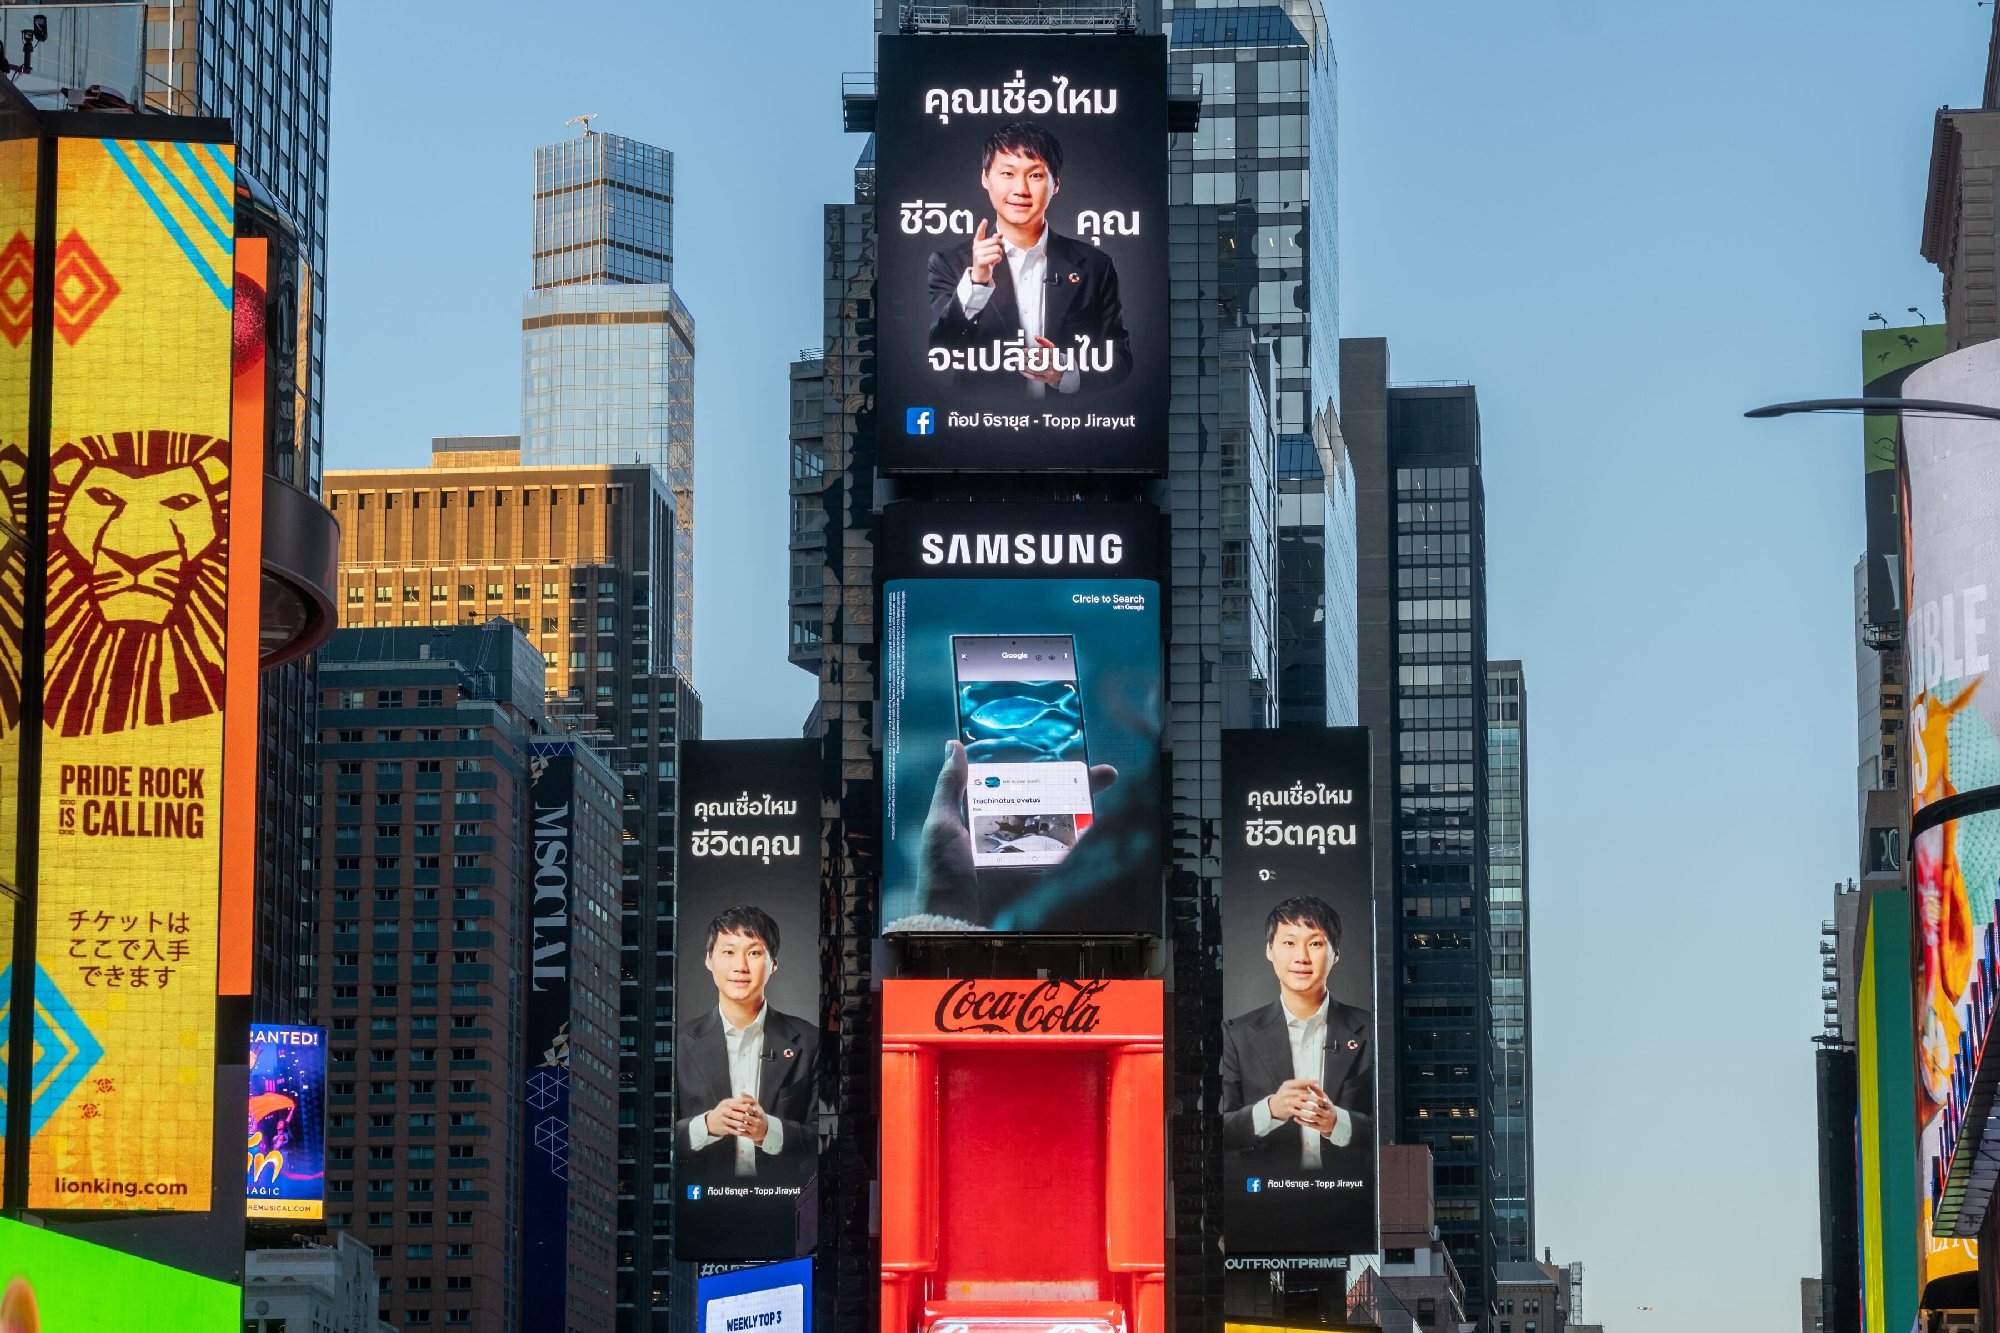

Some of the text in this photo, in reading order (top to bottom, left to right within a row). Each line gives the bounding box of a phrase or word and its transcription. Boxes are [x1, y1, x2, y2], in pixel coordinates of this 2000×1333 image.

[924, 70, 1118, 124] คุณเชื่อไหม
[900, 200, 1140, 246] ชีวิต คุณ
[928, 330, 1114, 373] จะเปลี่ยนไป
[983, 413, 1030, 431] จิรายุส
[1043, 413, 1080, 430] Topp
[1085, 413, 1136, 430] Jirayut
[921, 533, 1123, 565] SAMSUNG
[1072, 594, 1145, 604] Circle to Search
[1001, 652, 1028, 660] Google
[60, 764, 204, 799] PRIDE ROCK
[694, 791, 797, 822] คุณเชื่อไหม
[1248, 780, 1352, 812] คุณเชื่อไหม
[59, 799, 204, 839] IS CALLING
[691, 830, 800, 865] ชีวิตคุณ
[1245, 819, 1357, 855] ชีวิตคุณ
[68, 910, 190, 934] チケットは
[69, 939, 190, 962] ここで入手
[79, 965, 176, 989] できます
[934, 979, 1111, 1034] Coca-Cola
[250, 1030, 318, 1046] ANTED!
[55, 1177, 188, 1198] lionking.com
[246, 1186, 280, 1196] AGIC
[754, 1187, 774, 1196] Topp
[775, 1186, 801, 1196] Jirayut
[1315, 1179, 1335, 1189] Topp
[1336, 1179, 1363, 1189] Jirayut
[726, 1310, 782, 1332] WEEKLY TOP 3
